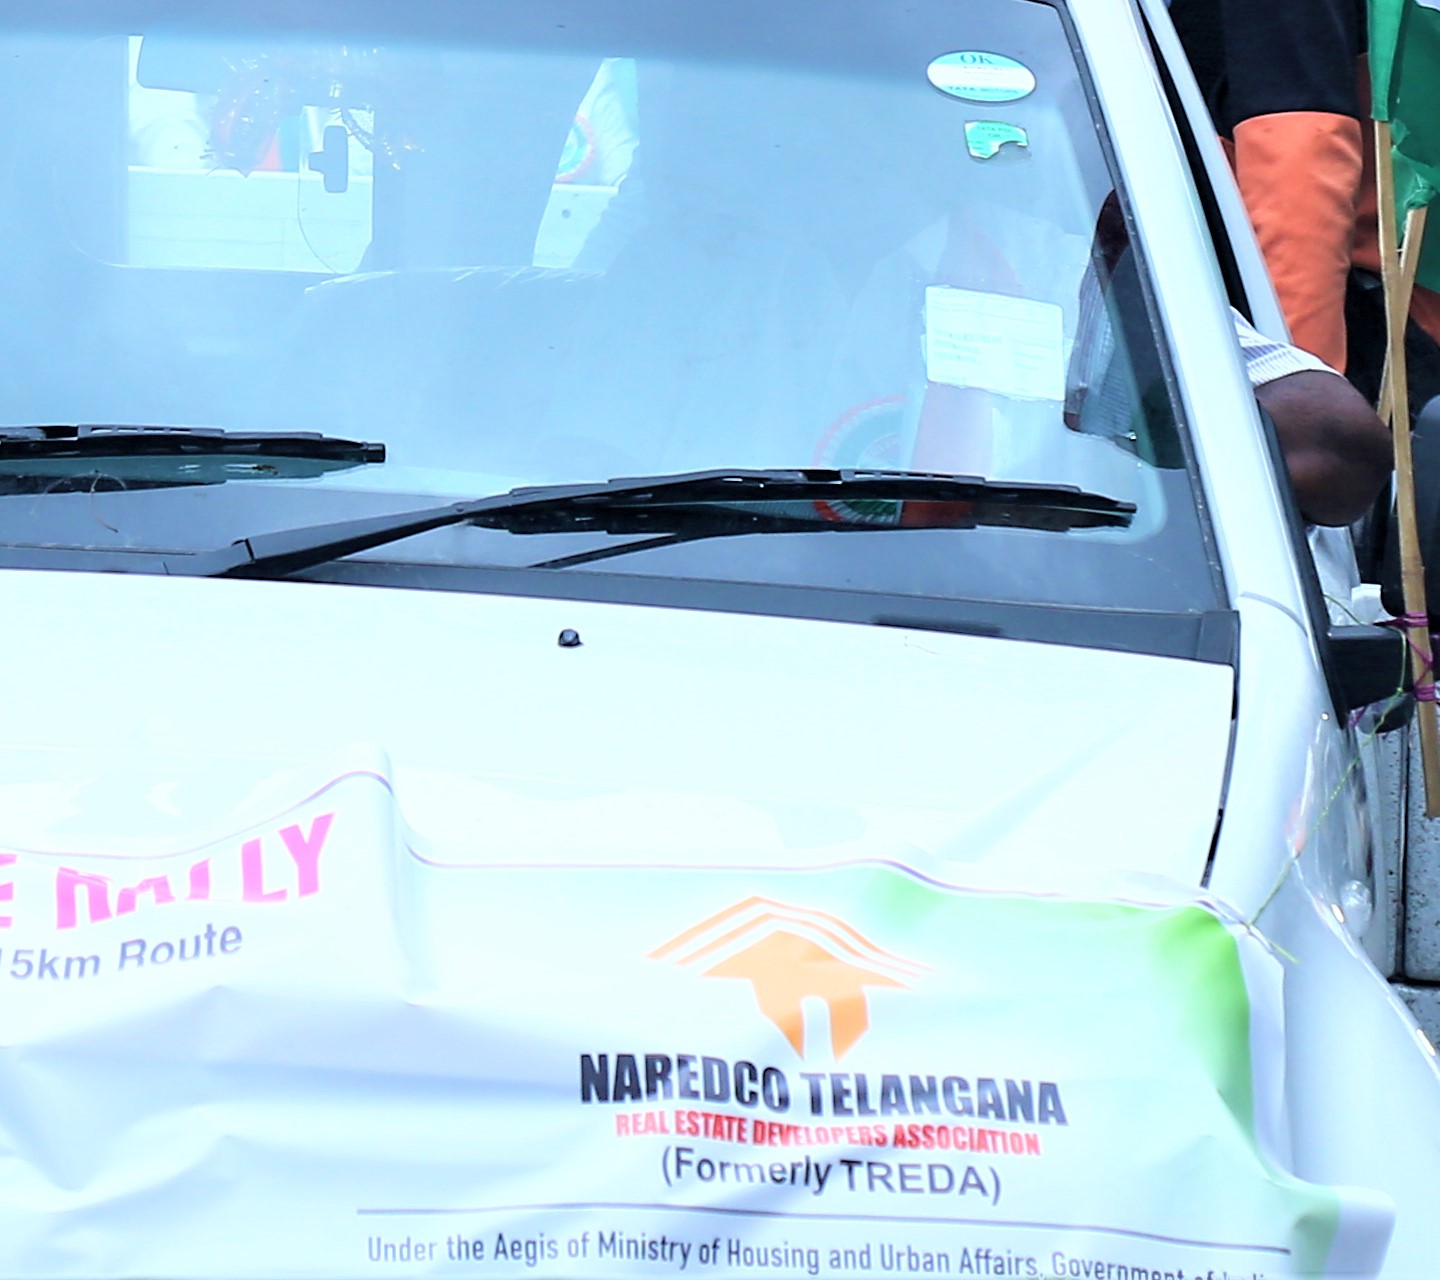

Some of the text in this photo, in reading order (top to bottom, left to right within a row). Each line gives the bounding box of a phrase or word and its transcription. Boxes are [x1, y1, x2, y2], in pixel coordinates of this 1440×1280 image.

[118, 922, 242, 972] Route
[580, 1053, 1069, 1126] NAREDCO TELANGANA
[615, 1109, 1042, 1156] REAL ESTATE DEVELOPERS ASSOCIATION
[661, 1145, 1002, 1207] (Formerly TREDA)
[368, 1236, 438, 1263] Under
[446, 1234, 484, 1261] the
[493, 1233, 559, 1267] Aegis
[567, 1231, 590, 1258] of
[598, 1231, 691, 1270] Ministry
[698, 1237, 720, 1265] of
[727, 1238, 820, 1275] Housing
[828, 1242, 871, 1271] and
[880, 1243, 951, 1274] Urban
